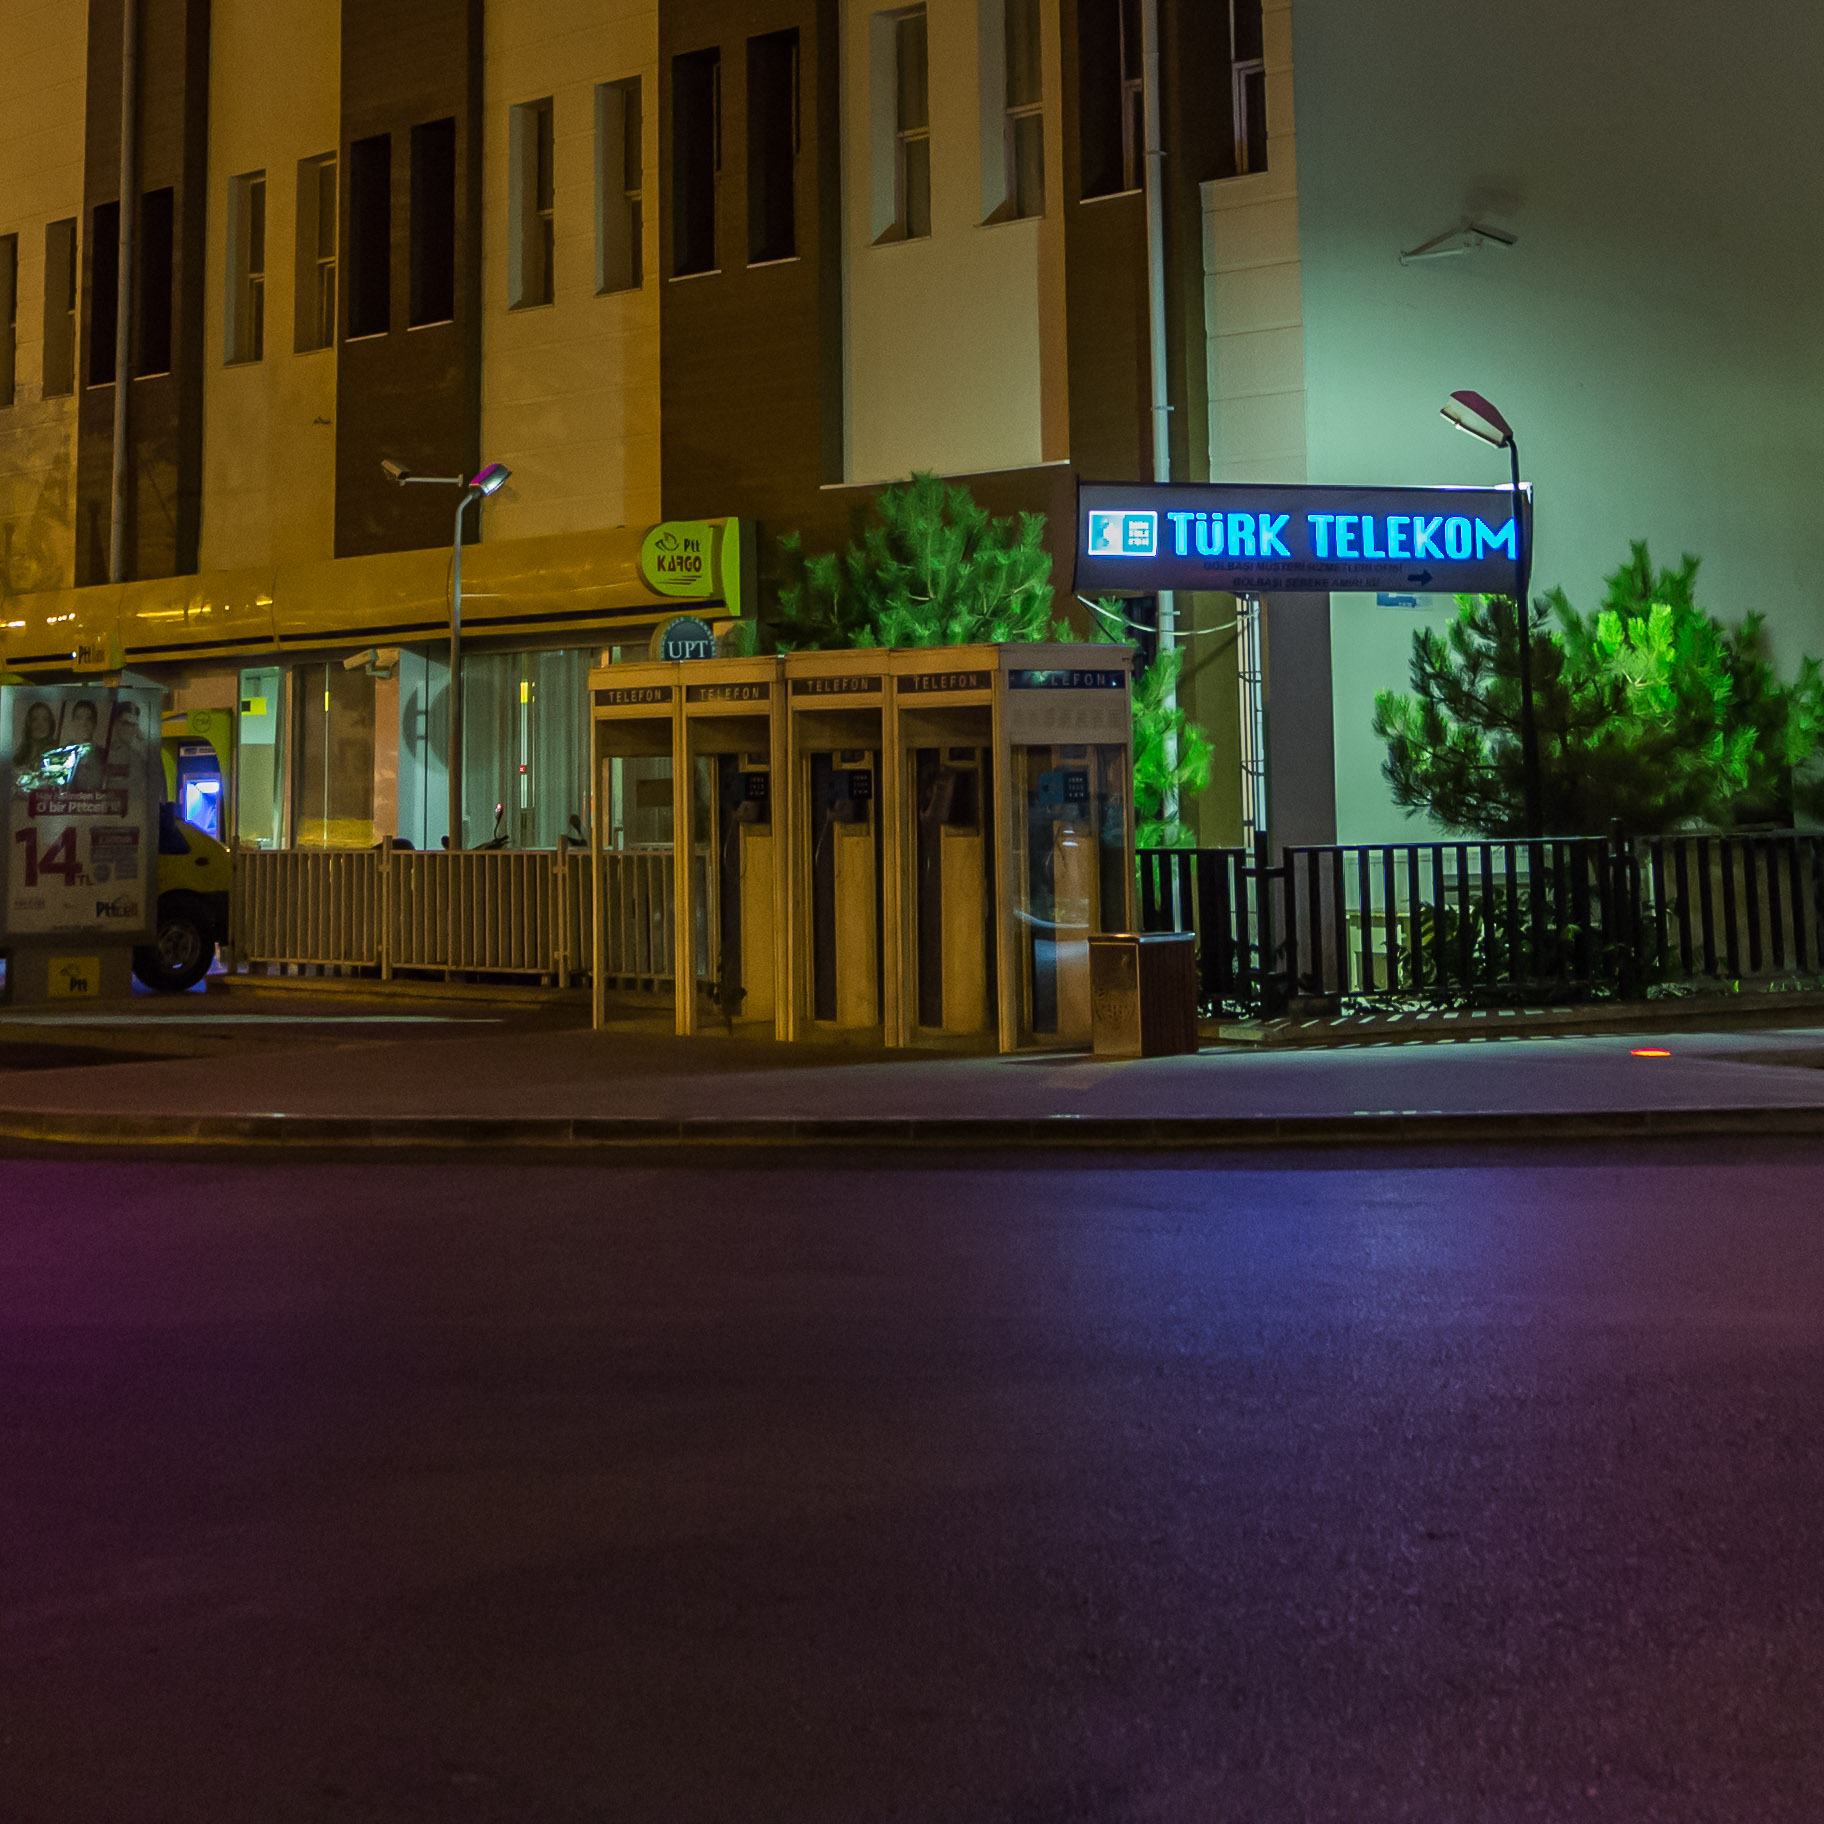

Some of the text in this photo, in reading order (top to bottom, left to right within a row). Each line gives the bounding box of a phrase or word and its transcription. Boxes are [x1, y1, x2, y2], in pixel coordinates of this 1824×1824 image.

[1167, 512, 1291, 558] TÜRK
[1307, 514, 1518, 560] TELEKOM
[683, 538, 700, 553] Ptt
[657, 555, 702, 573] KARGO
[667, 639, 709, 660] UPT
[807, 677, 869, 693] TELEFON
[913, 674, 977, 691] TELEFON
[609, 689, 662, 704] TELEFON
[699, 686, 759, 702] TELEFON
[15, 827, 83, 887] 14
[77, 875, 94, 887] TL
[70, 977, 88, 992] Ptt
